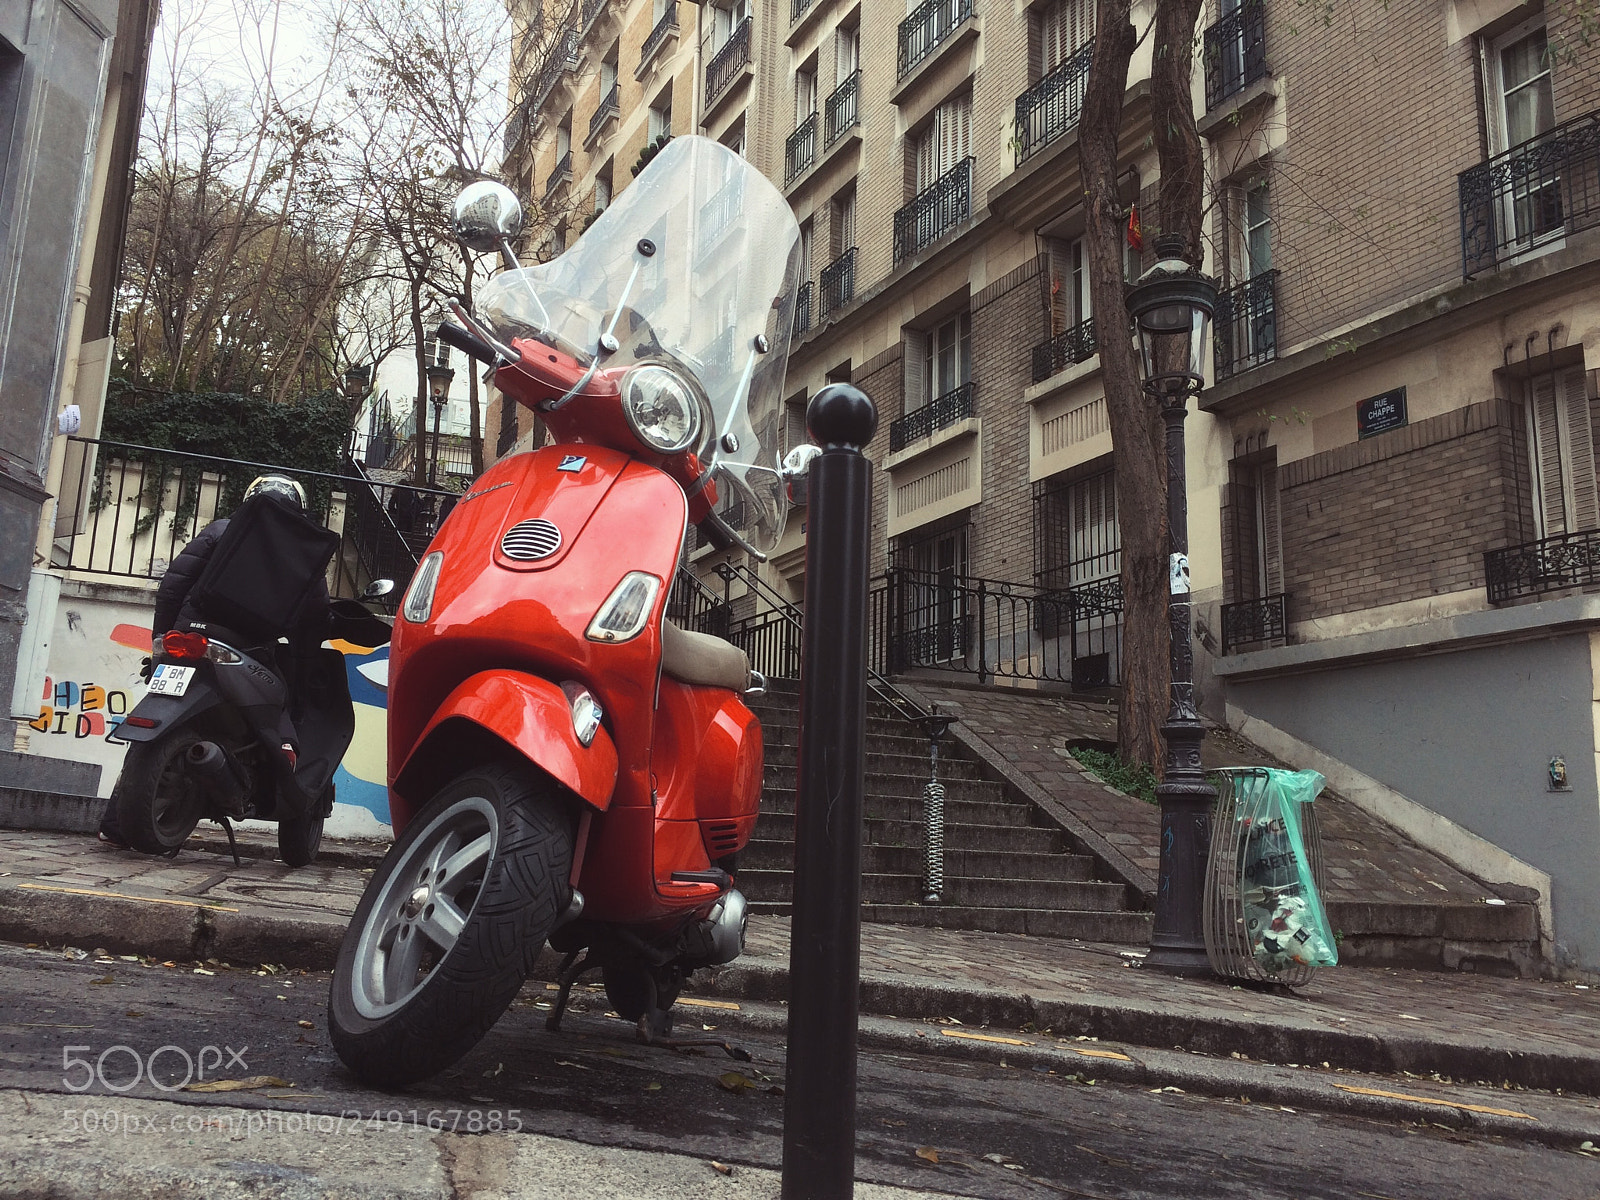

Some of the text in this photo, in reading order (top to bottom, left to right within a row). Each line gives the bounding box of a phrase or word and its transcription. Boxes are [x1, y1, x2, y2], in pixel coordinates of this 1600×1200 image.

[1374, 397, 1388, 409] RUE
[1368, 404, 1395, 420] CHAPPE
[189, 622, 207, 630] MBK
